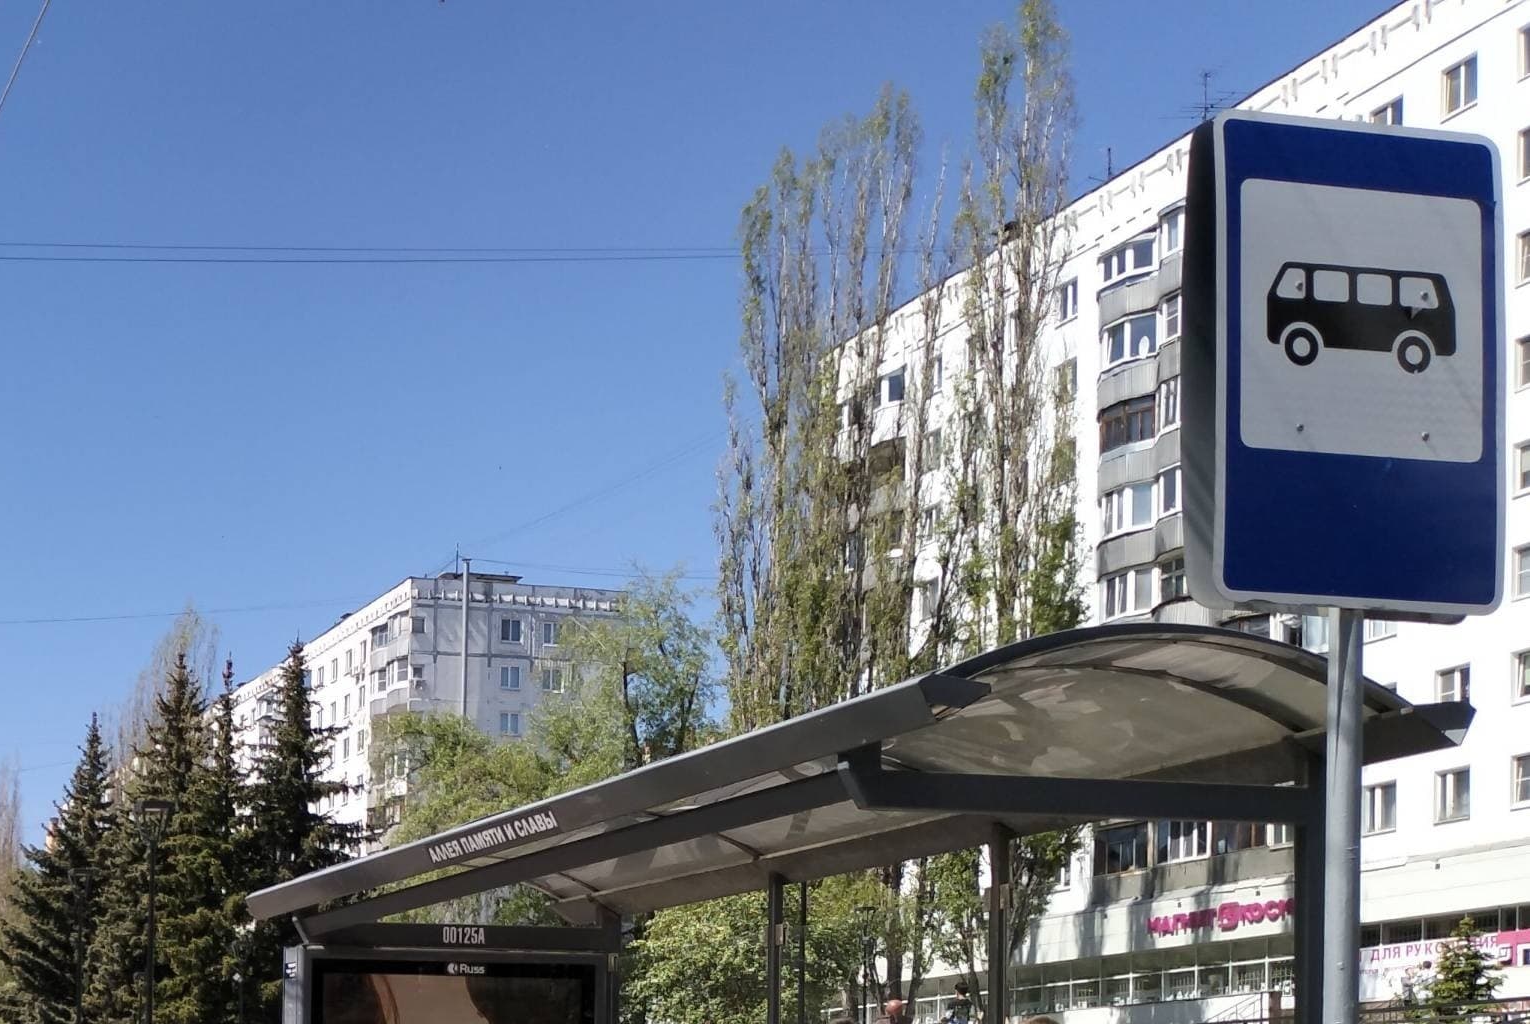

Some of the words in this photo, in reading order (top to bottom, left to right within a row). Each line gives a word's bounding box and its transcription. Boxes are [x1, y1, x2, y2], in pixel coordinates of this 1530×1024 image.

[428, 839, 464, 864] АЛЛЕЯ
[461, 826, 507, 855] ПАМЯТИ
[503, 823, 517, 841] И
[513, 811, 559, 837] СЛАВЫ
[1371, 946, 1401, 963] ДЛЯ
[459, 963, 486, 975] Russ
